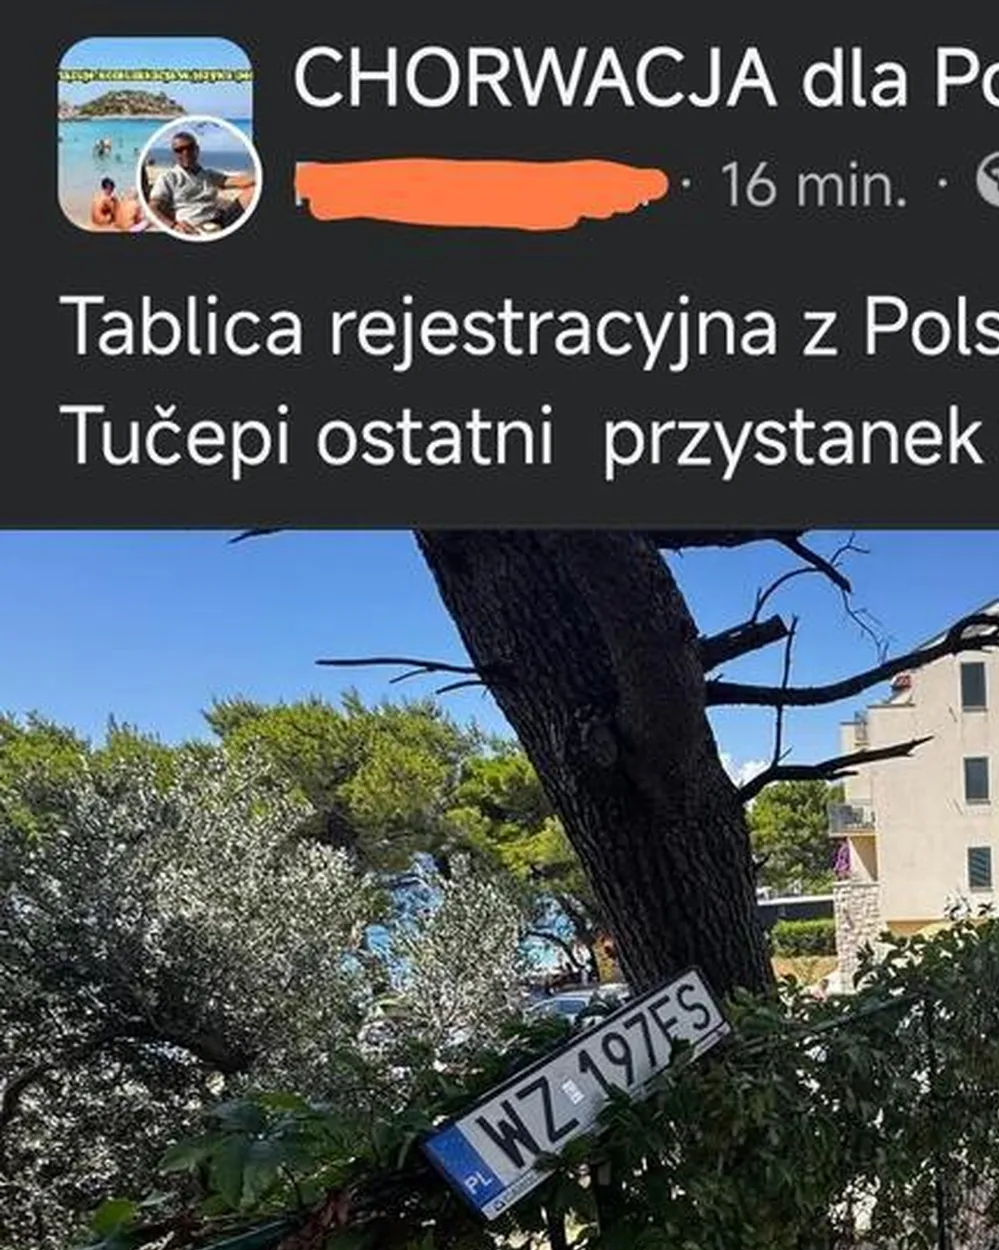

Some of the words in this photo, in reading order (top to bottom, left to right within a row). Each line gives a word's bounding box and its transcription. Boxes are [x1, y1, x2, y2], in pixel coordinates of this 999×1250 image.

[475, 1075, 581, 1170] WZ
[577, 983, 711, 1100] 197FS
[464, 1172, 493, 1195] PL
